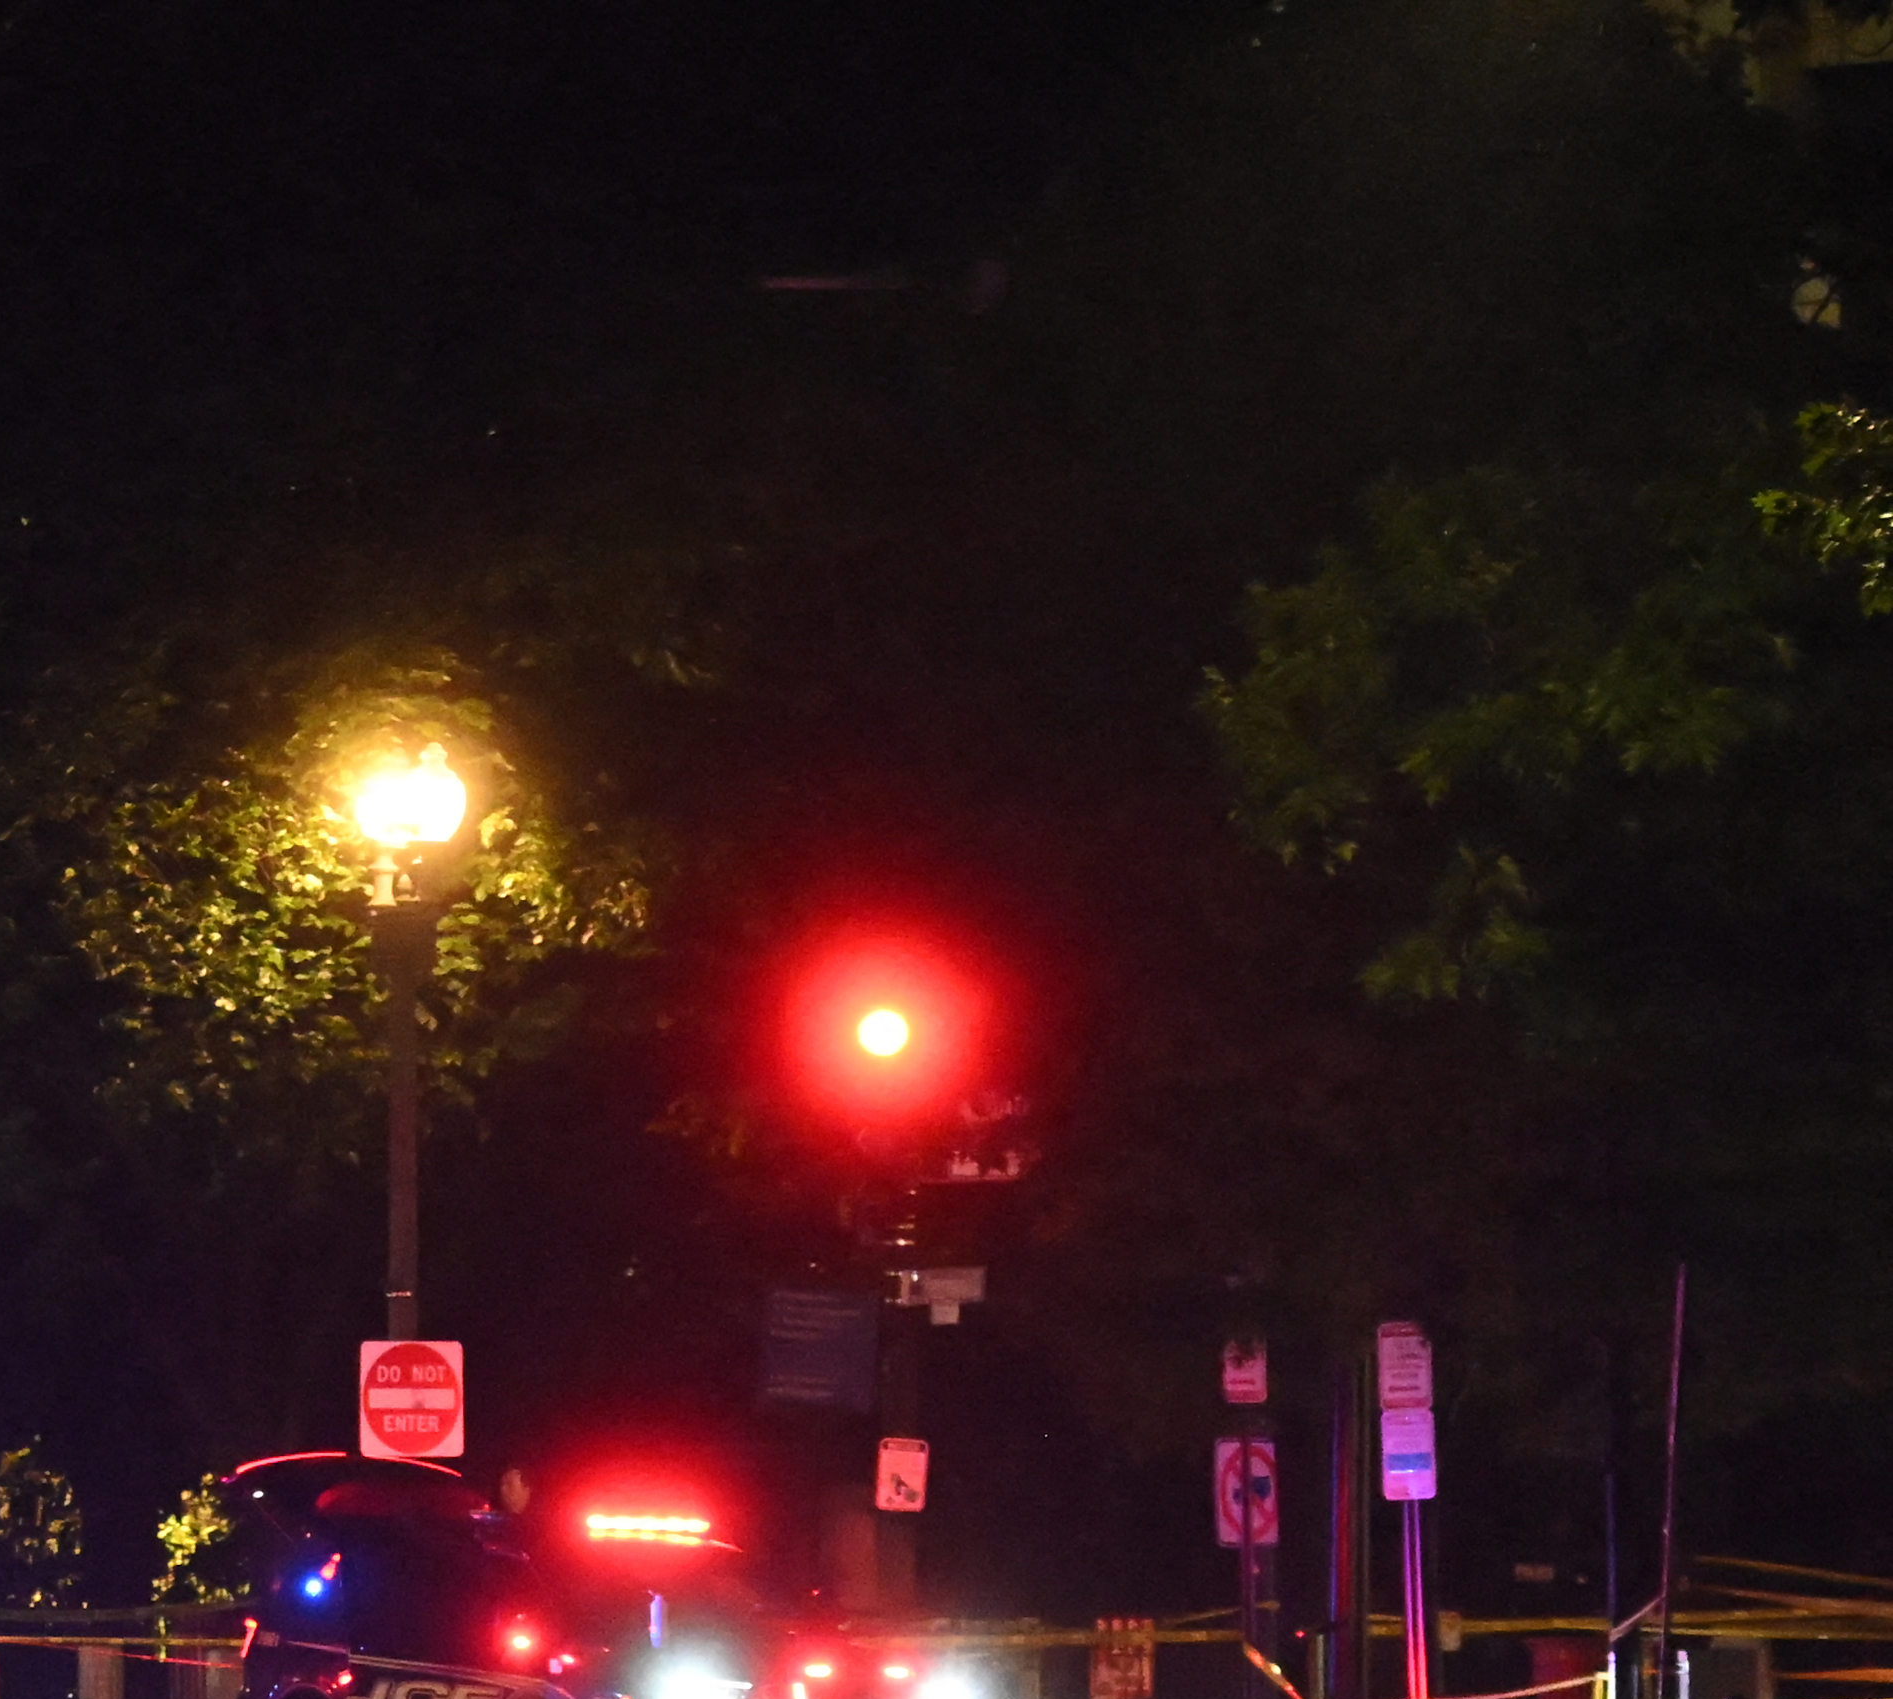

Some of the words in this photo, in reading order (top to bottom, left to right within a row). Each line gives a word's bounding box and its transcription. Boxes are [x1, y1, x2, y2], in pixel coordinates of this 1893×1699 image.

[377, 1365, 401, 1383] DO
[412, 1365, 447, 1382] NOT
[383, 1414, 440, 1433] ENTER
